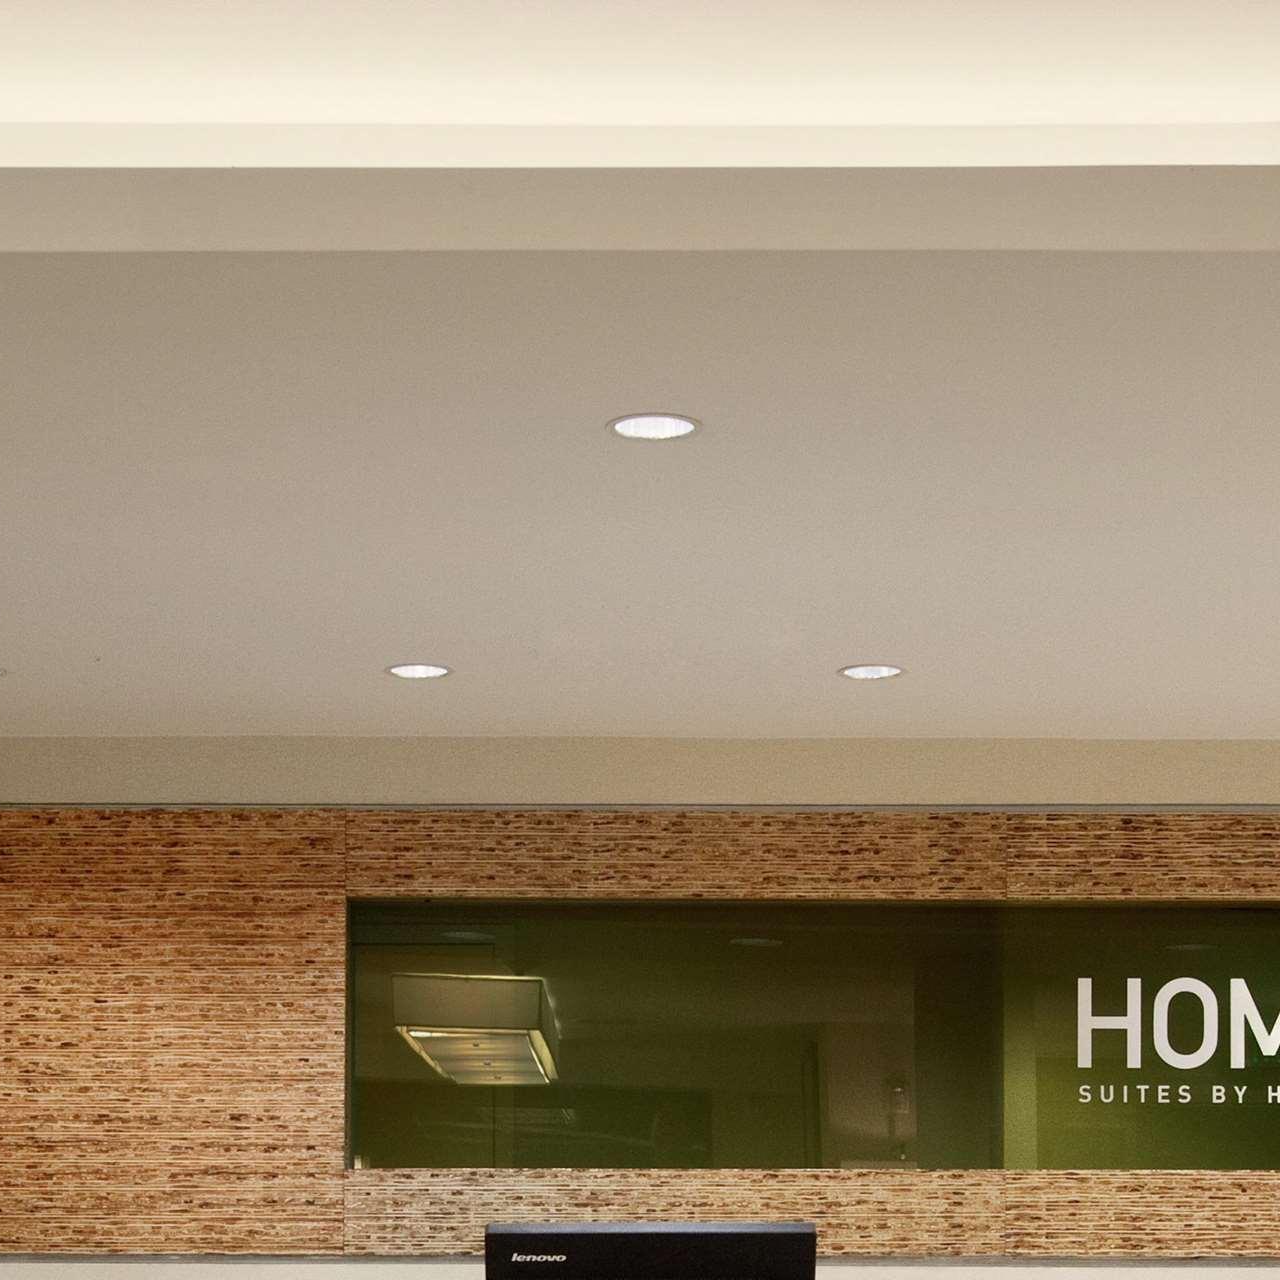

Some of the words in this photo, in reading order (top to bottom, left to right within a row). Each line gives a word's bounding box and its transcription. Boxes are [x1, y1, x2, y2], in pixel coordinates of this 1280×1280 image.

[1078, 1085, 1192, 1104] SUITES
[1211, 1085, 1248, 1104] BY
[511, 1252, 567, 1262] lenovo
